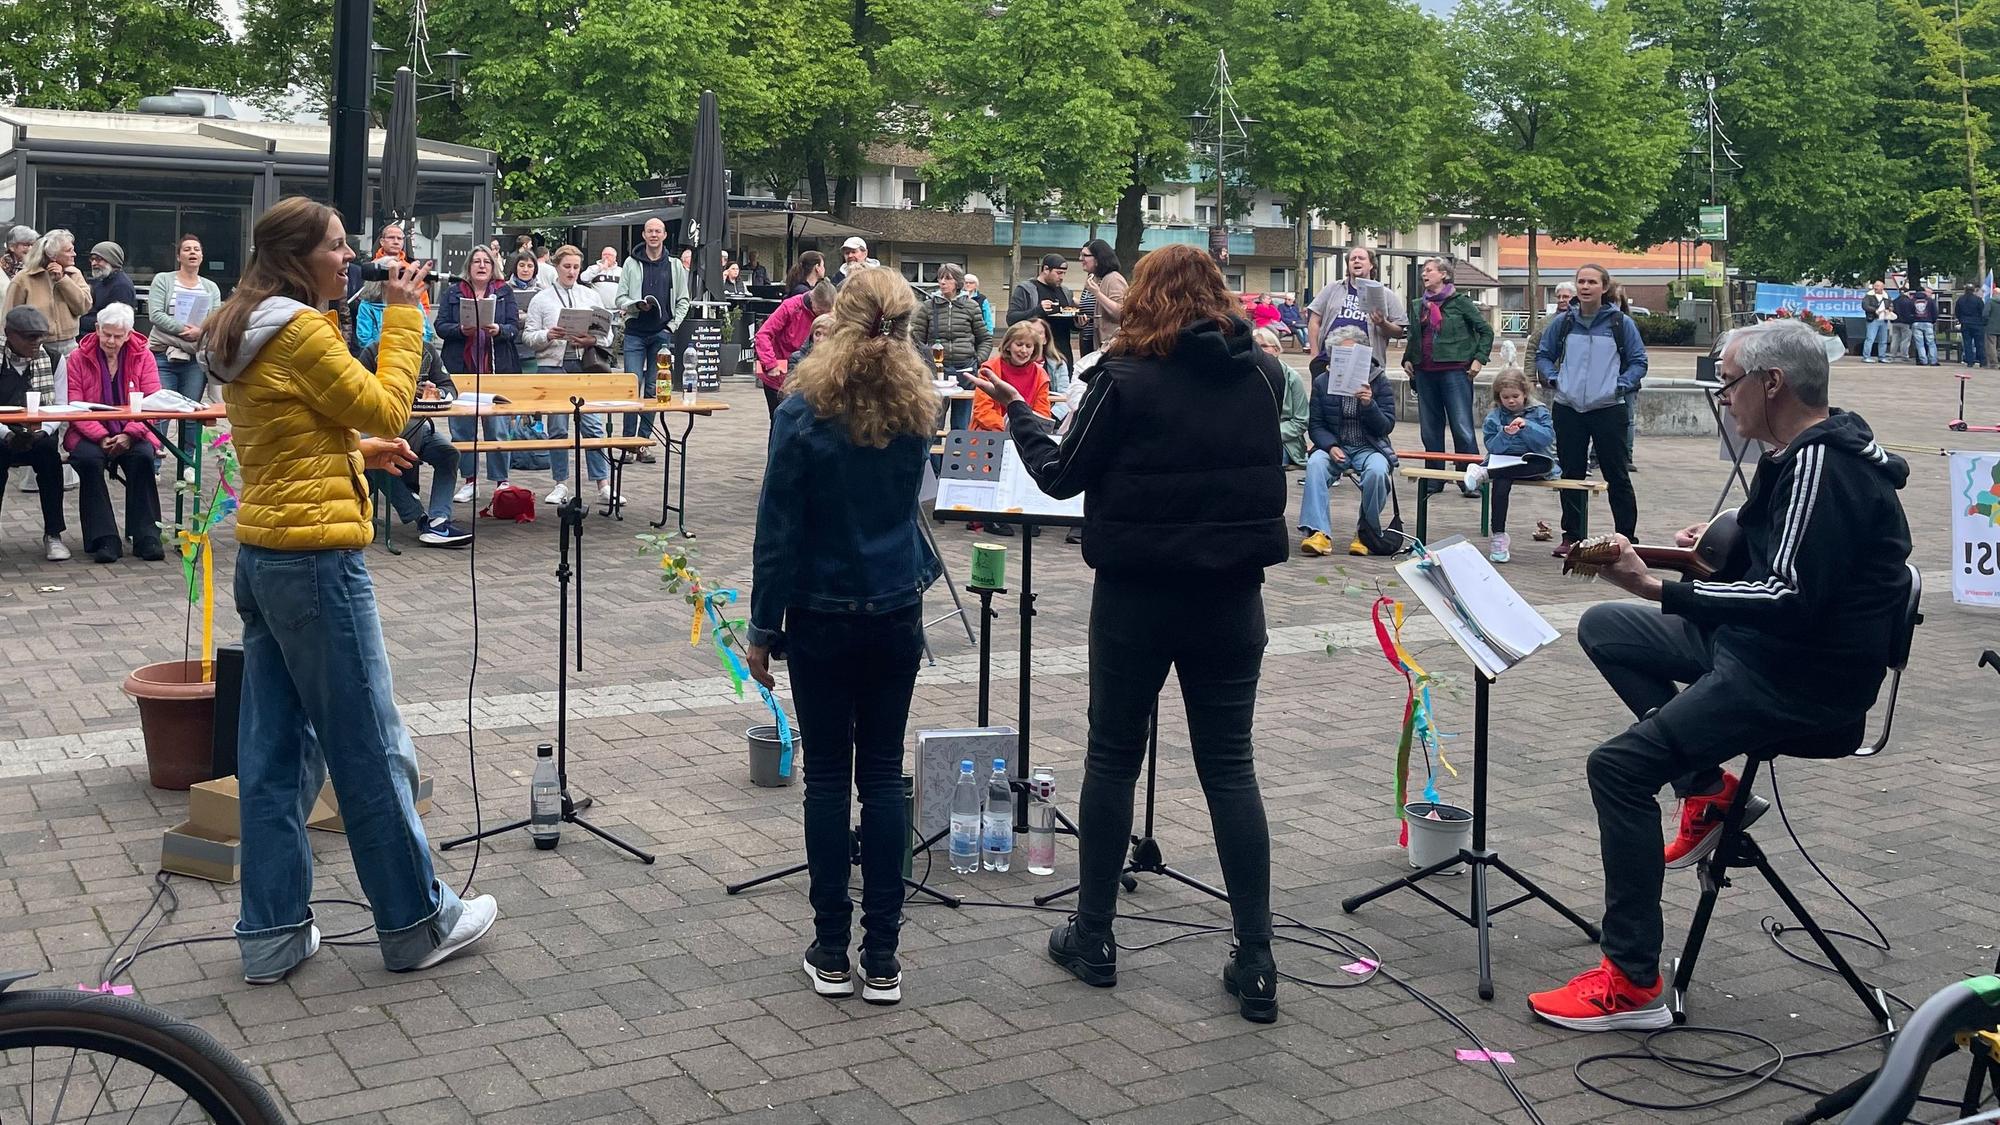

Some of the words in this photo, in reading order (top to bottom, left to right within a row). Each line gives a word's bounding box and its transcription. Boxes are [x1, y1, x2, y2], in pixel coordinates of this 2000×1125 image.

[1806, 288, 1840, 298] Kein
[1844, 288, 1866, 298] Pla
[1808, 301, 1863, 311] Faschis
